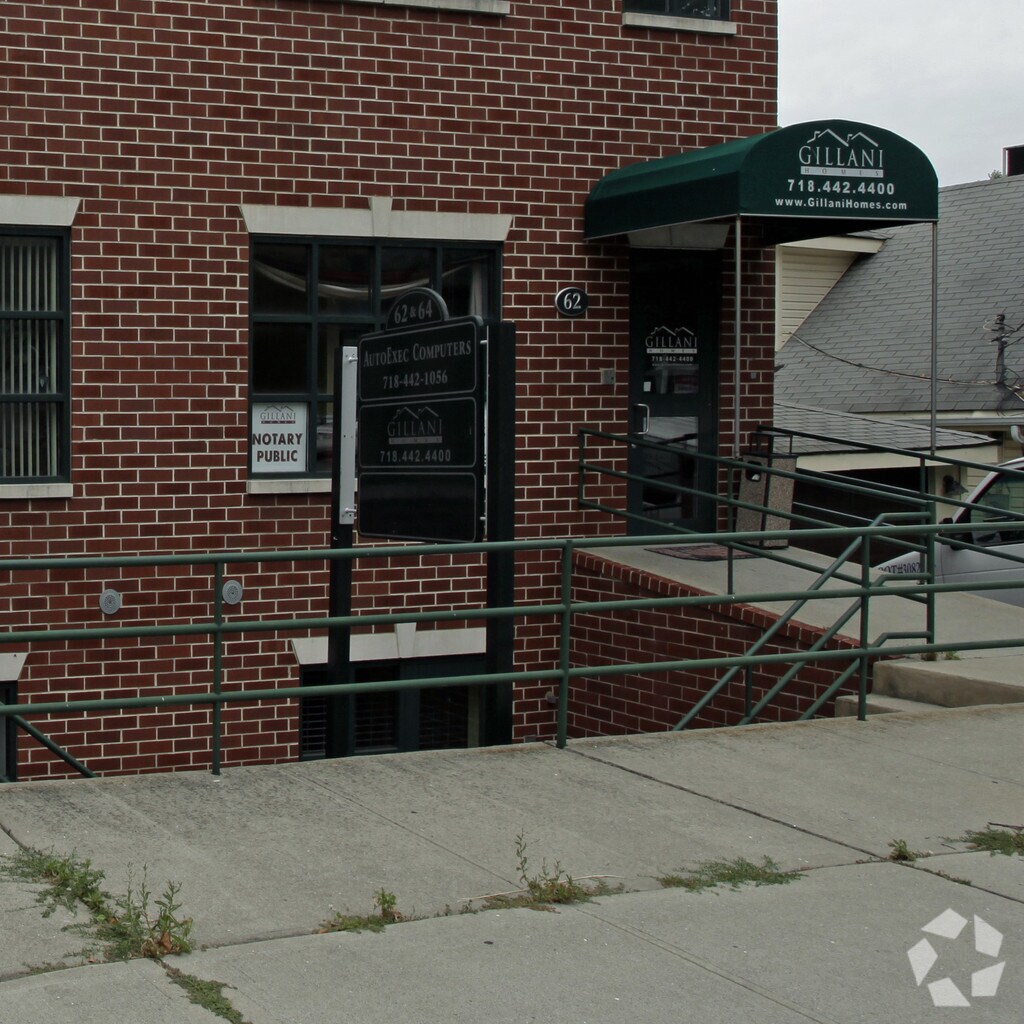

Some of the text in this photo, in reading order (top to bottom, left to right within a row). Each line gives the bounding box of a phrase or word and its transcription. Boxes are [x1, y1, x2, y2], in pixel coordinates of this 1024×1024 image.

[798, 145, 884, 168] GILLANI
[787, 179, 895, 195] 718.442.4400
[775, 197, 907, 210] www.GillaniHomes.com
[563, 292, 582, 310] 62
[394, 304, 408, 324] 62
[418, 299, 433, 320] 64
[645, 336, 697, 348] GILLANI
[383, 369, 448, 390] 718-442-1056
[387, 418, 443, 437] GILLANI
[252, 433, 303, 446] NOTARY
[257, 450, 298, 463] PUBLIC
[380, 449, 452, 463] 718.442.4400
